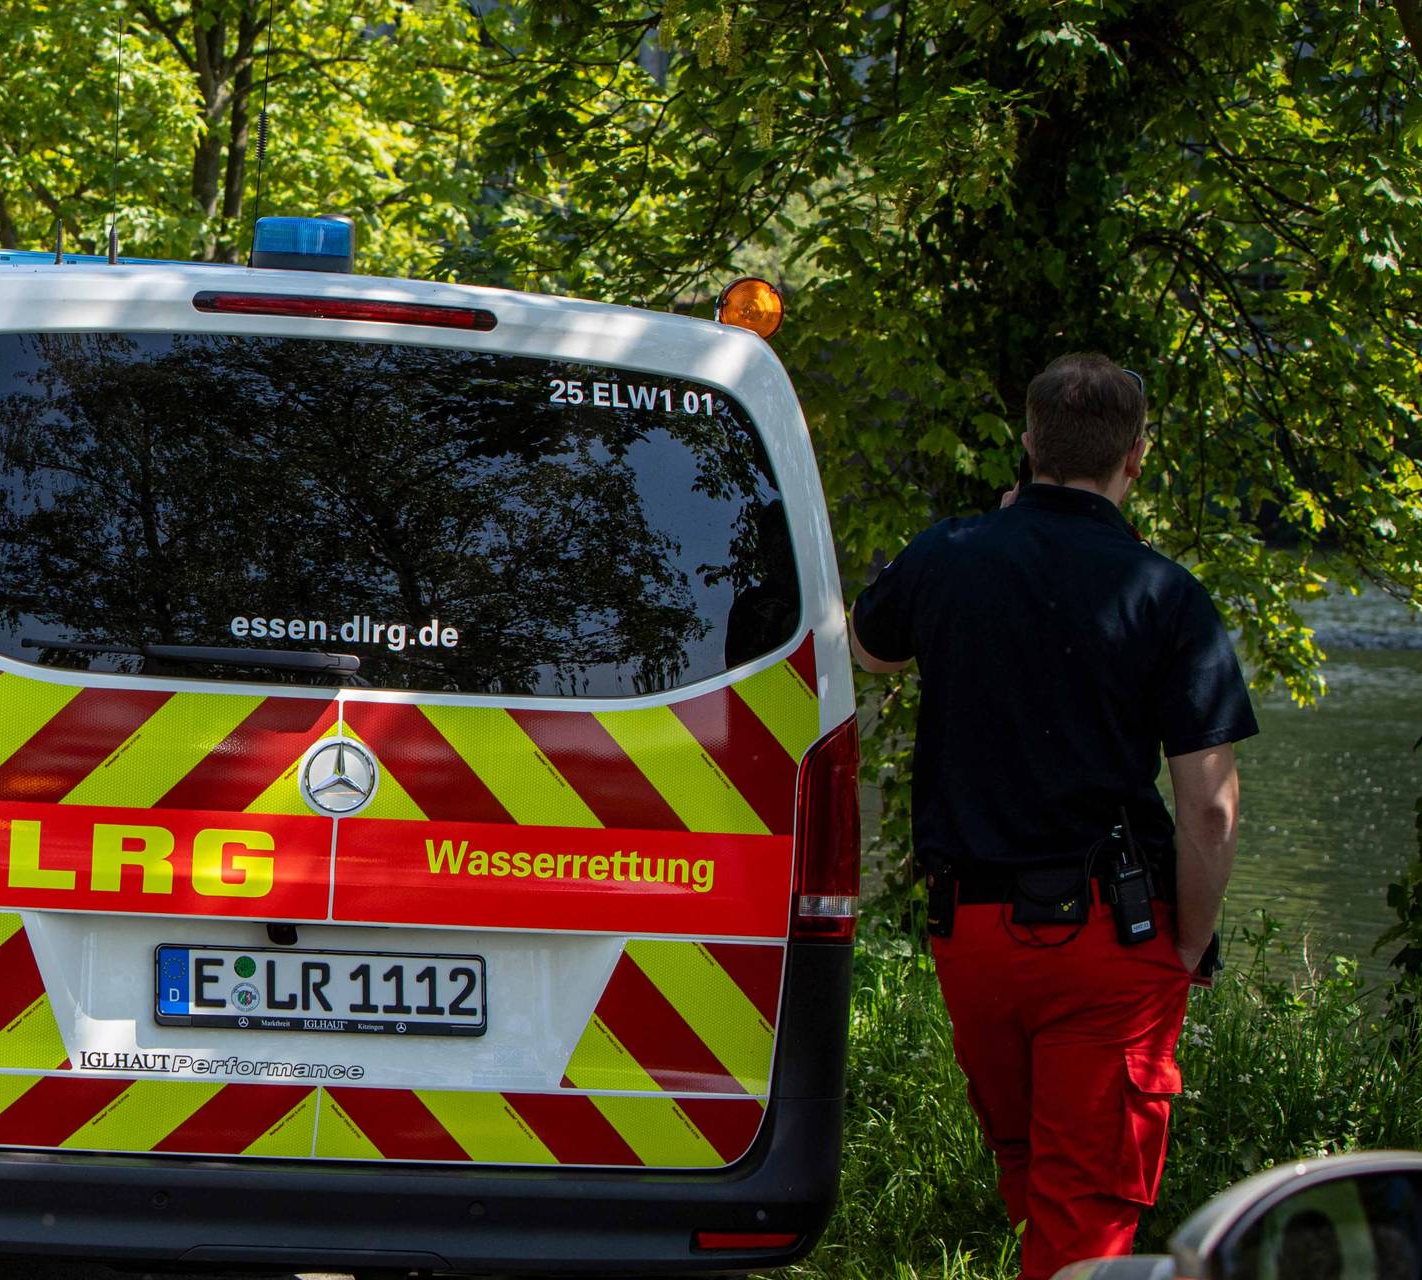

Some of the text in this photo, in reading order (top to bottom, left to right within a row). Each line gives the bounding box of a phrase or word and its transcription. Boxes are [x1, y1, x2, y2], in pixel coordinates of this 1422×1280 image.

[549, 379, 714, 416] 25 ELW1 01
[230, 615, 459, 651] essen.dlrg.de
[425, 839, 715, 893] Wasserrettung
[194, 958, 226, 1007] E
[266, 960, 333, 1012] LR
[349, 964, 477, 1016] 1112
[80, 1051, 365, 1080] IGLHAUT Performance
